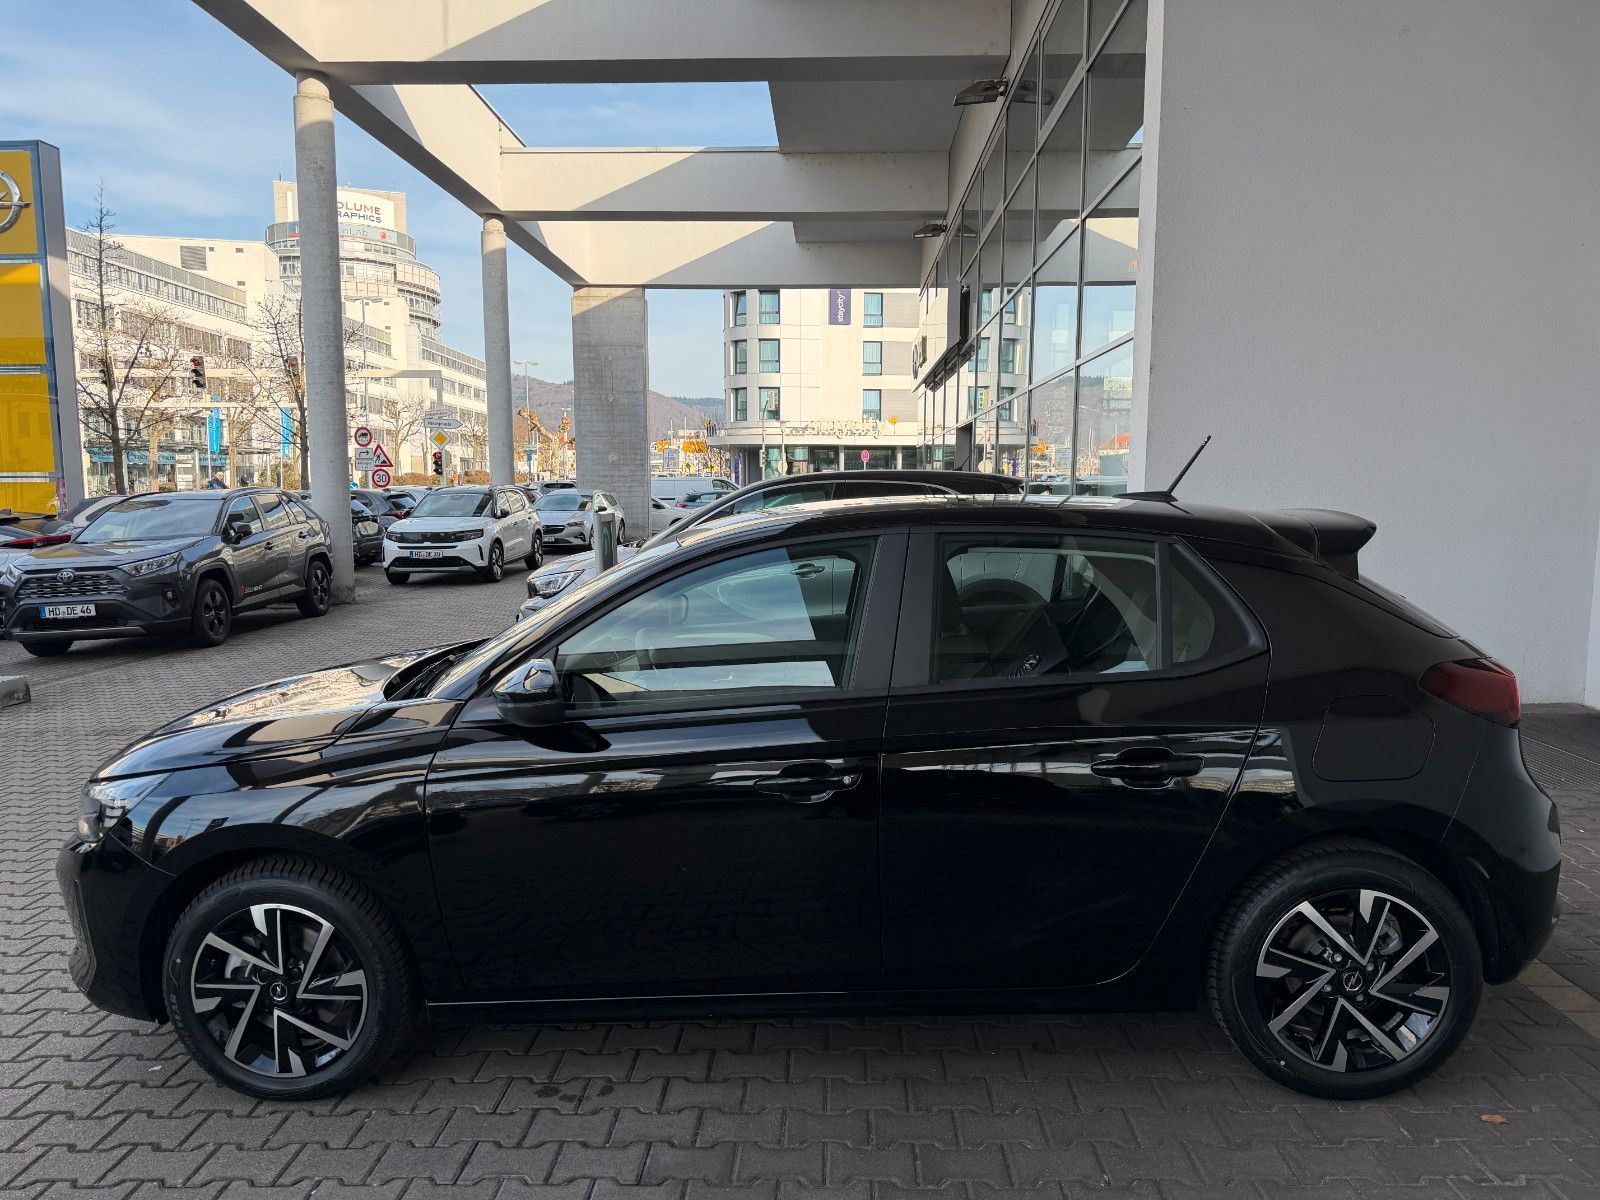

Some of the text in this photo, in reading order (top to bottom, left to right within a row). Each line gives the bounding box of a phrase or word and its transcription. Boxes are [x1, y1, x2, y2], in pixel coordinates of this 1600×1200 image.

[337, 201, 381, 216] OLUME
[337, 210, 382, 224] RAPHICS
[376, 473, 387, 483] 30
[48, 605, 92, 617] HD DE 46
